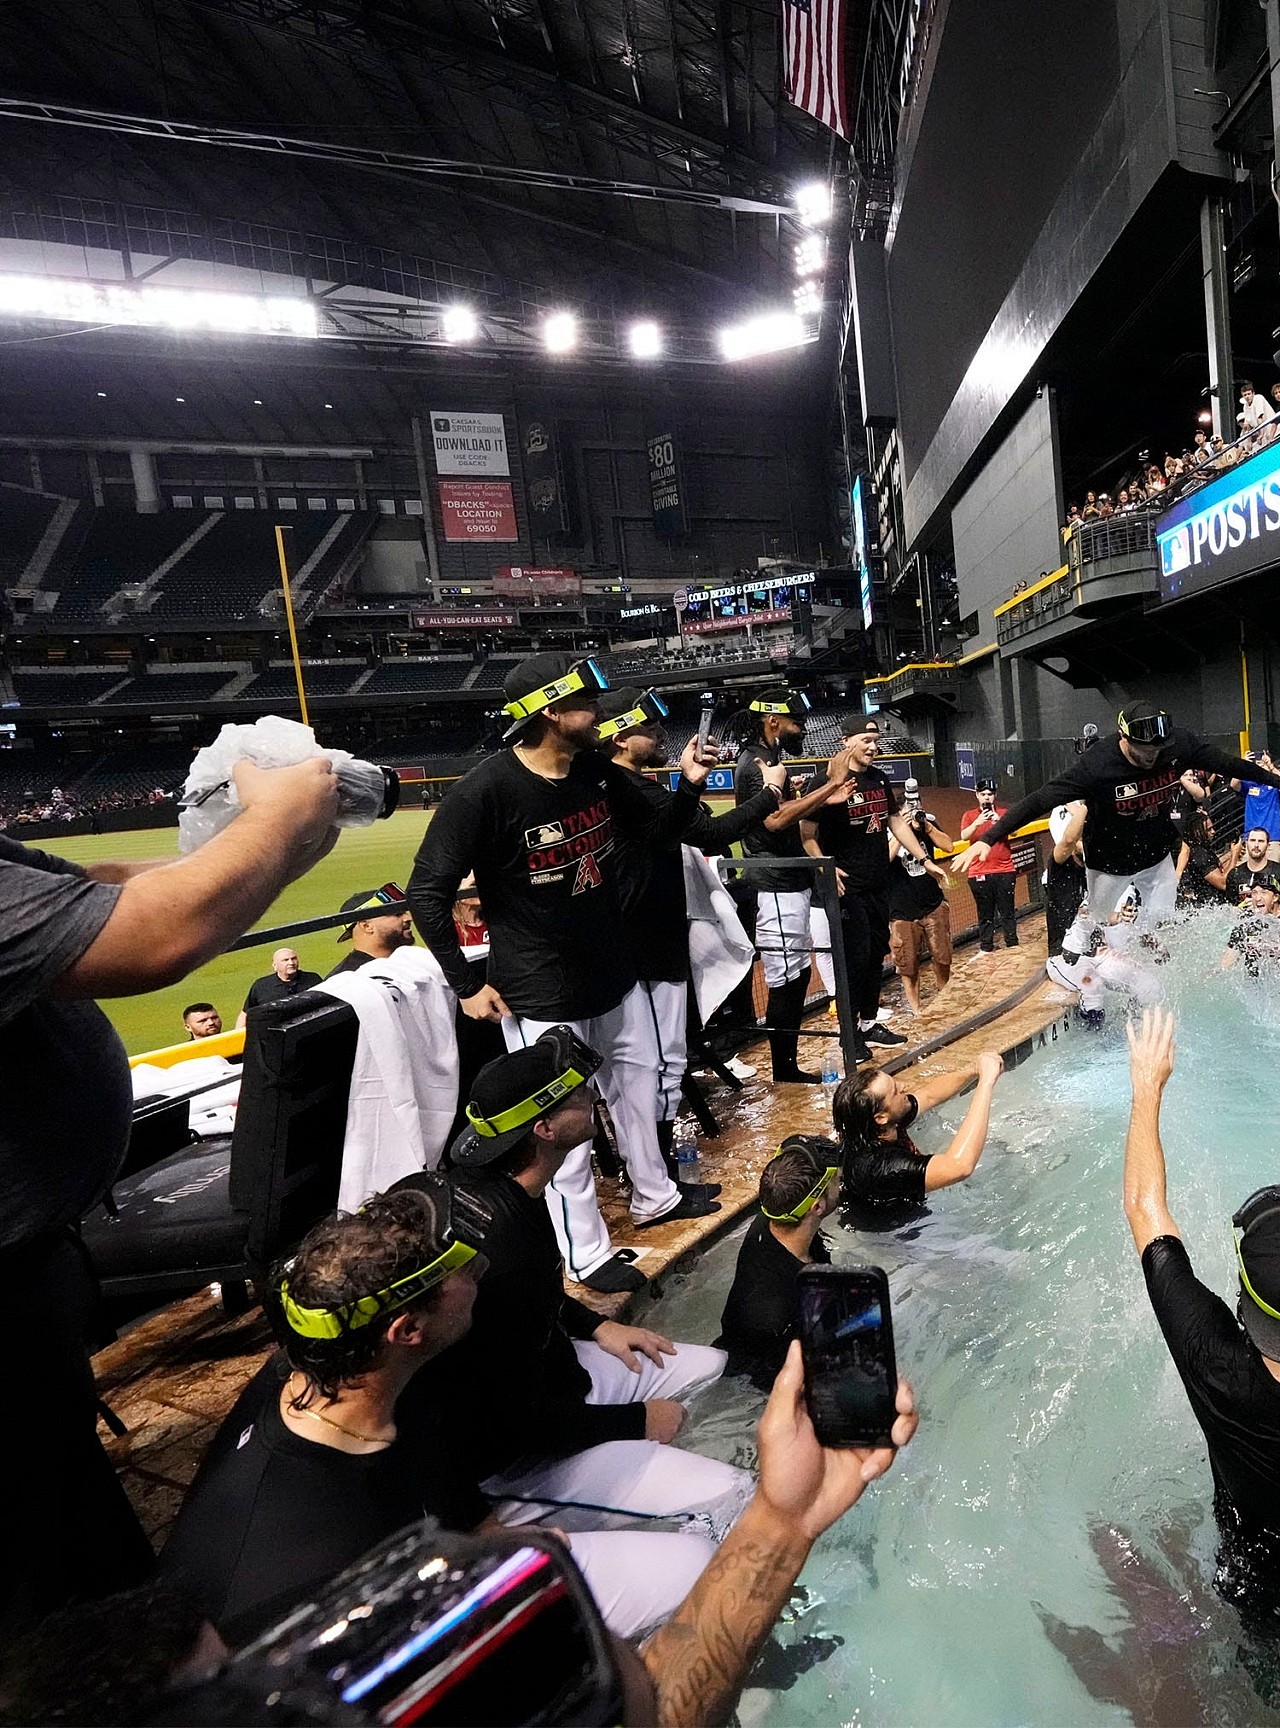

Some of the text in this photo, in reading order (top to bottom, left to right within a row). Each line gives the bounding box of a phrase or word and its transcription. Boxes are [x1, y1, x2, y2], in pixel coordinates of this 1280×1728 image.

[451, 425, 503, 434] SPORTSBOOK
[435, 437, 504, 452] DOWNLOAD IT
[648, 441, 674, 468] $80
[650, 465, 676, 482] MILLION
[653, 493, 679, 511] GIVING
[456, 510, 502, 518] LOCATION
[466, 525, 497, 533] 69050
[688, 591, 709, 603] COLD
[709, 586, 736, 599] BEERS
[736, 585, 743, 594] &
[743, 572, 816, 594] CHEESEBURGERS
[429, 616, 503, 625] ALL-YOU-CAN-EAT SEATS
